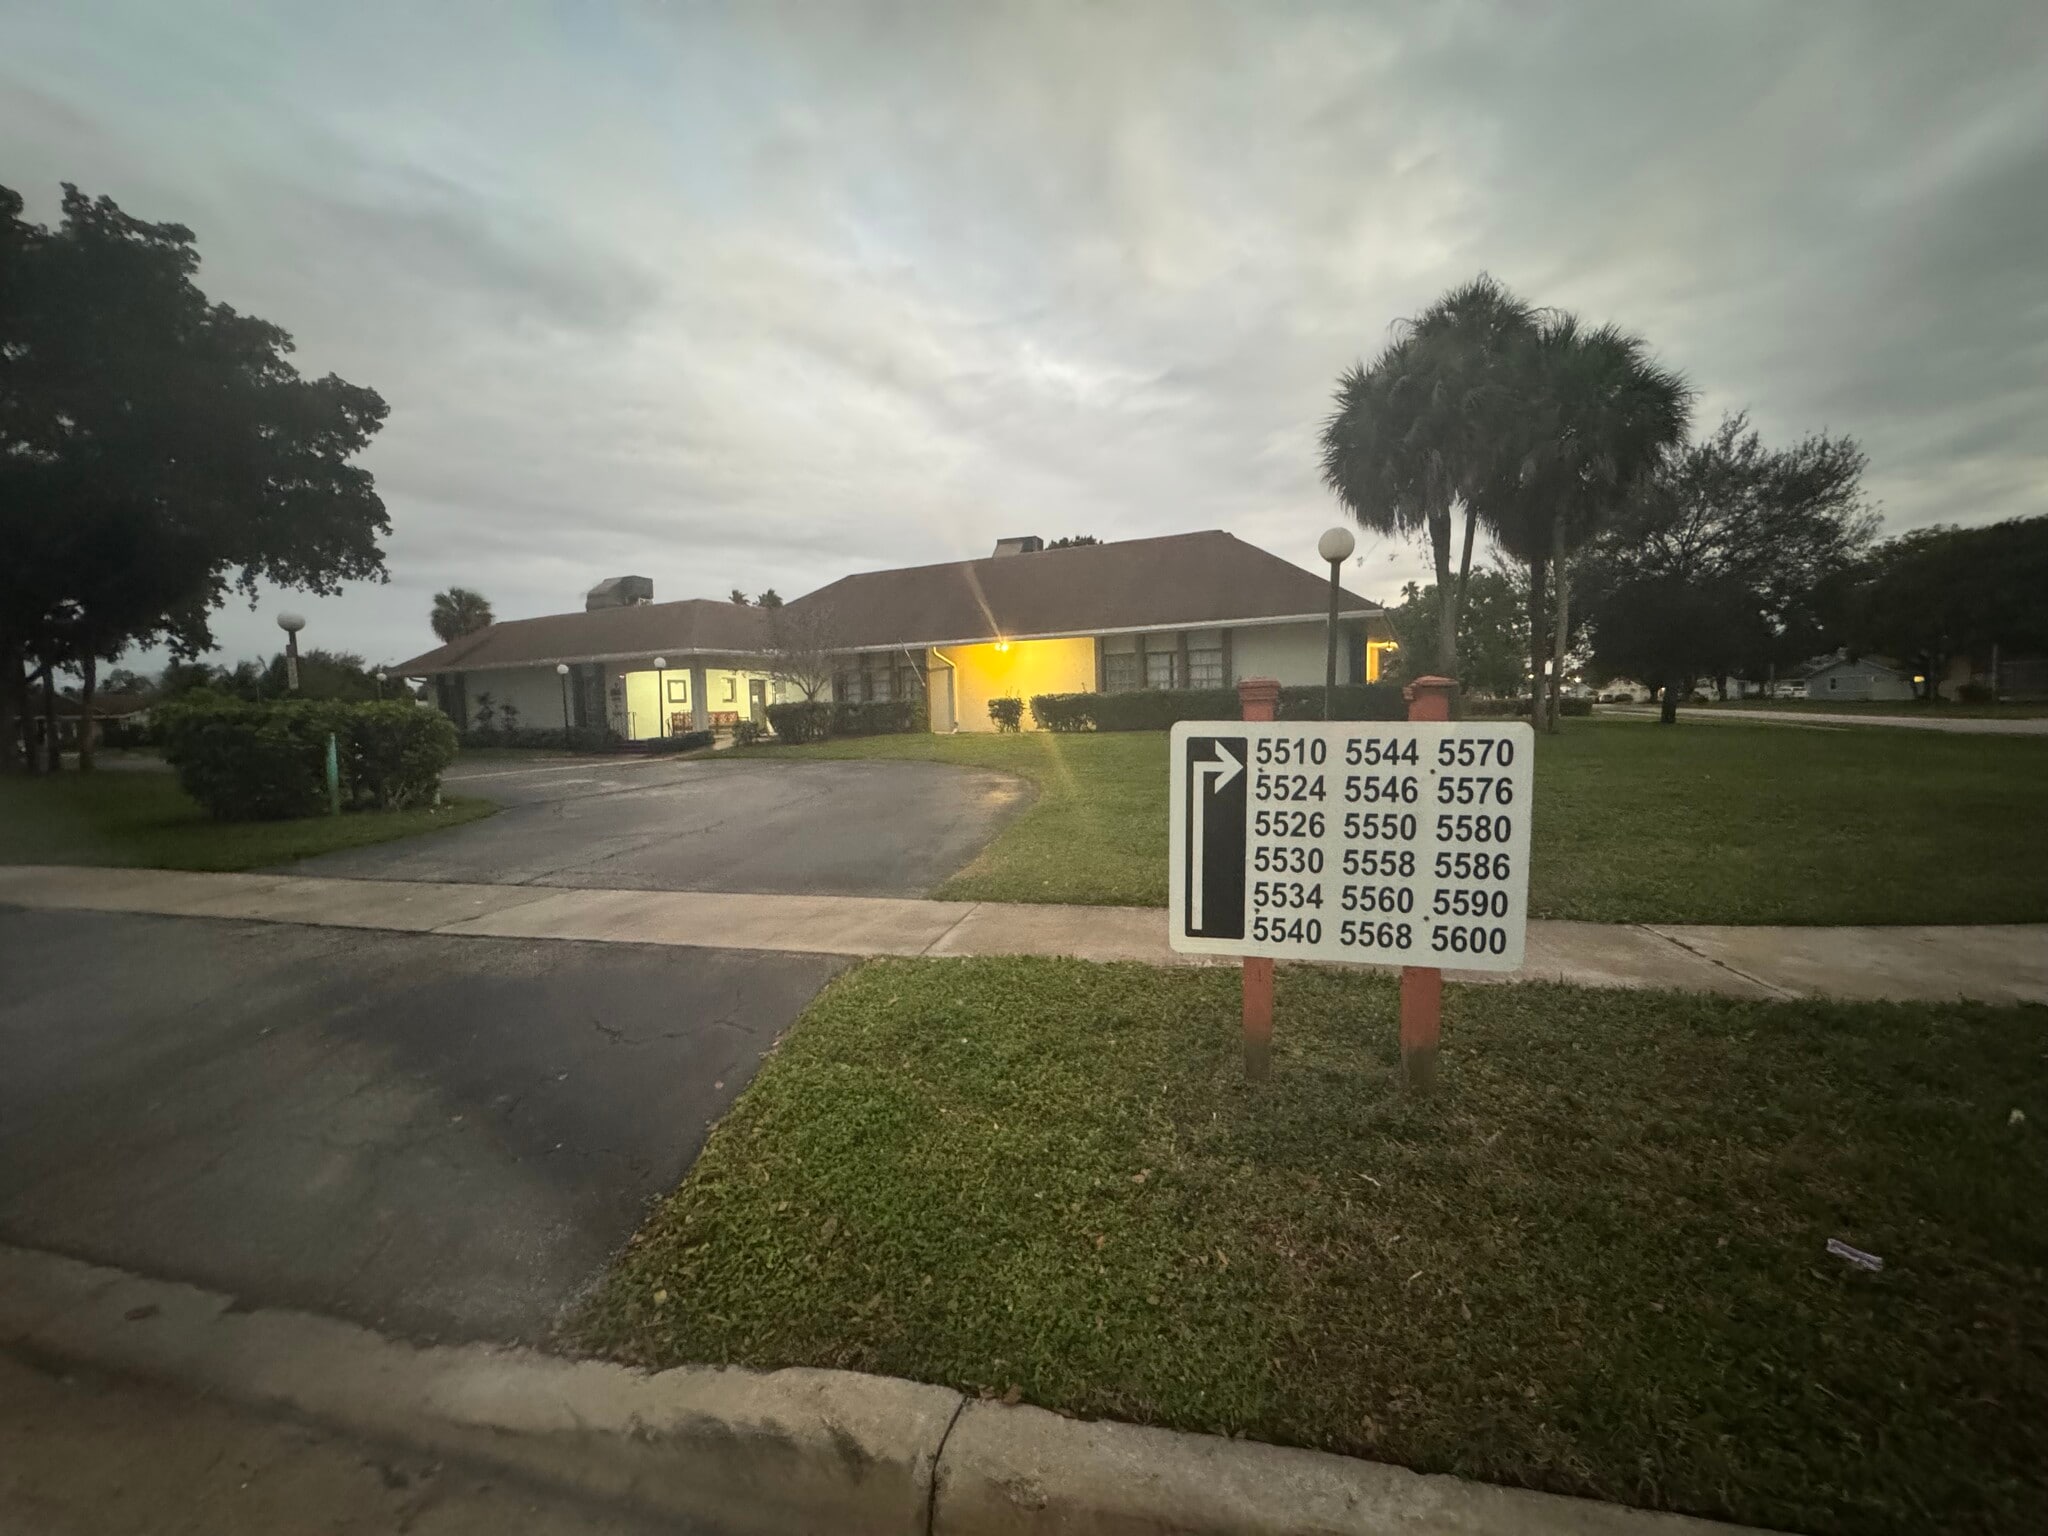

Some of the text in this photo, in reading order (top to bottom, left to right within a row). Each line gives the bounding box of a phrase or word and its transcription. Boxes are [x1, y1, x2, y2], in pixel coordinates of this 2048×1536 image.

[1256, 738, 1326, 765] 5510
[1346, 739, 1419, 766] 5544
[1438, 739, 1514, 767] 5570
[1256, 775, 1326, 801] 5524
[1345, 776, 1418, 803] 5546
[1437, 777, 1513, 805] 5576
[1255, 811, 1325, 838] 5526
[1344, 813, 1416, 841] 5550
[1436, 815, 1511, 843] 5580
[1255, 847, 1323, 874] 5530
[1343, 849, 1415, 877] 5558
[1434, 852, 1510, 880] 5586
[1254, 882, 1323, 909] 5534
[1341, 885, 1413, 913] 5560
[1433, 889, 1508, 918] 5590
[1253, 917, 1321, 944] 5540
[1340, 920, 1412, 949] 5568
[1431, 925, 1507, 955] 5600
